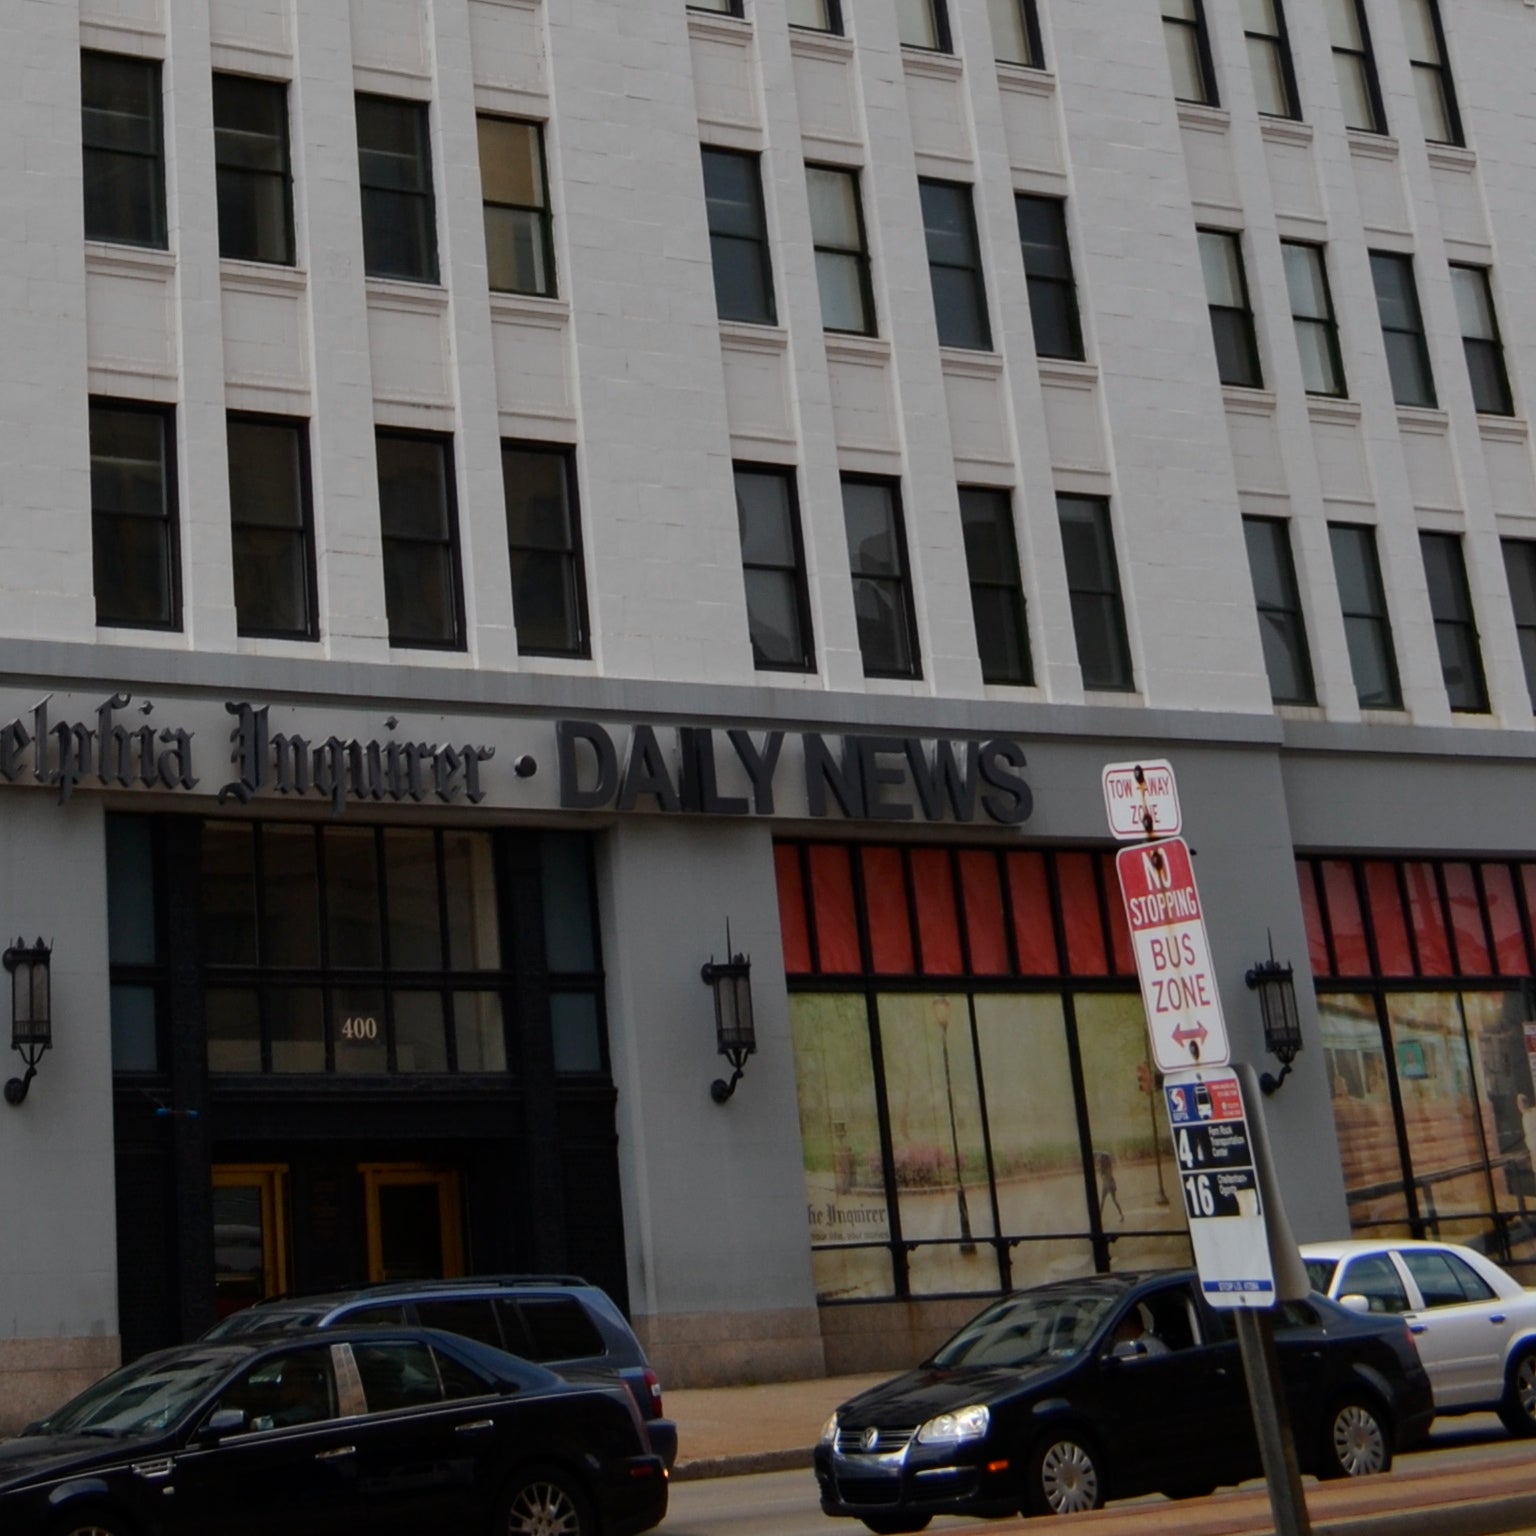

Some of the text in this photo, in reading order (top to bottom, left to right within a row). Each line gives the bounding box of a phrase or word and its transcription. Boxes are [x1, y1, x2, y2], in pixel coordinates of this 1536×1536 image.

[219, 700, 496, 818] Inquirer
[557, 719, 786, 815] DAILY
[801, 731, 1034, 826] NEWS
[1141, 847, 1172, 891] NO
[1130, 886, 1197, 926] STOPPING
[1150, 933, 1195, 970] BUS
[1152, 973, 1211, 1013] ZONE
[342, 1017, 377, 1038] 400
[808, 1203, 886, 1227] he Inquirer
[1186, 1174, 1215, 1216] 16
